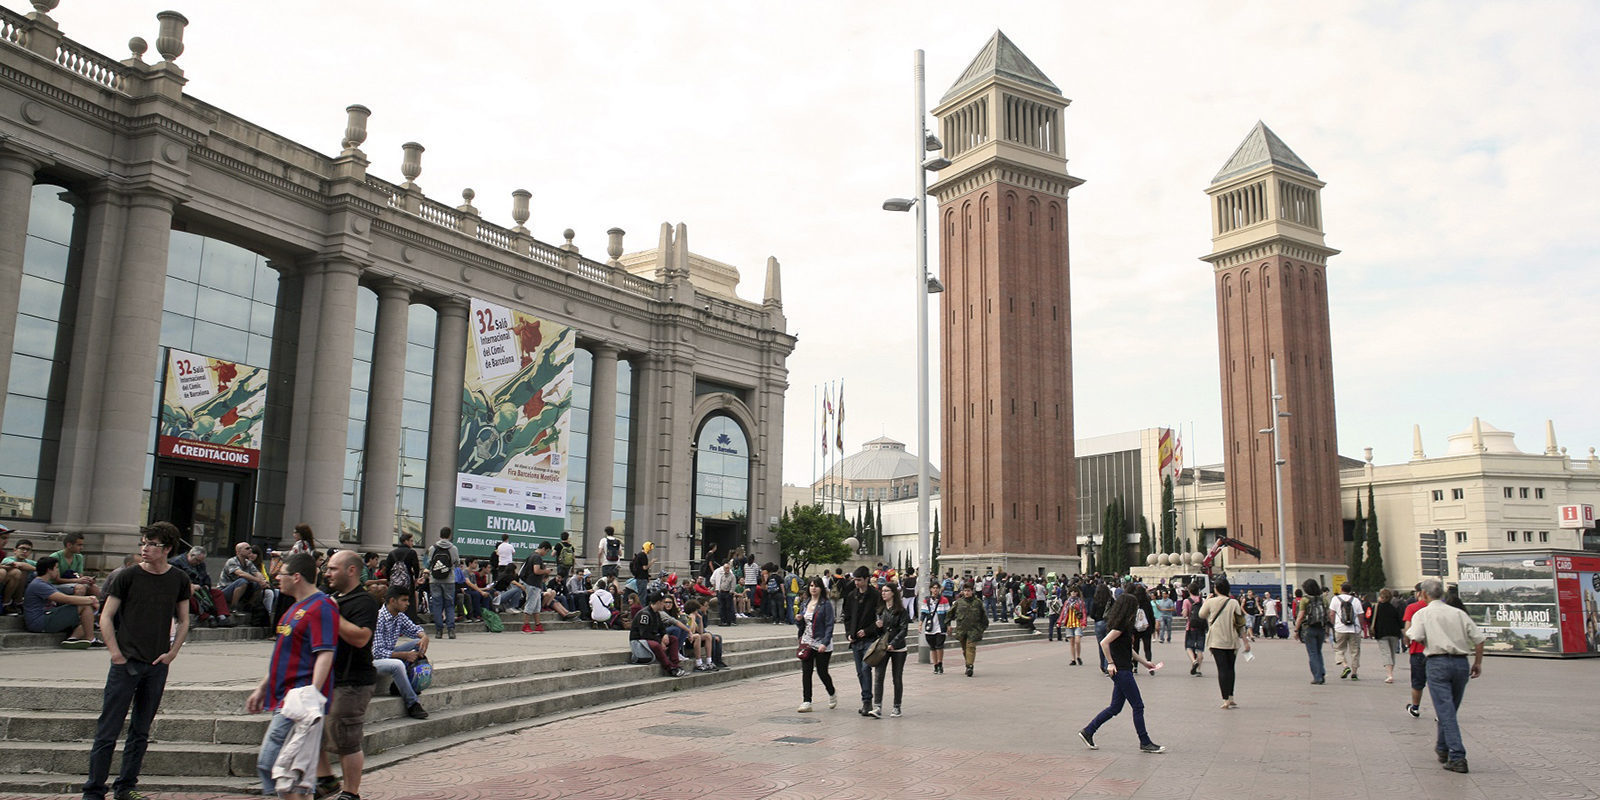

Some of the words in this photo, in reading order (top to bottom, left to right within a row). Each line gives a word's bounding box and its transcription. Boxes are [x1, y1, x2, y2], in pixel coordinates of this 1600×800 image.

[476, 308, 495, 334] 32
[495, 318, 508, 330] Saló
[480, 331, 511, 345] Internacional
[483, 346, 491, 357] del
[176, 359, 193, 376] 32
[485, 360, 491, 368] de
[492, 355, 515, 367] Barcelona
[172, 444, 249, 464] ACREDITACIONS
[507, 468, 517, 476] Fira
[517, 470, 540, 479] Barcelona
[487, 515, 536, 533] ENTRADA
[467, 537, 485, 545] MARIA
[1556, 561, 1572, 570] CARD
[640, 614, 649, 625] R
[1496, 610, 1522, 621] GRAN
[1523, 608, 1550, 622] JARDÍ
